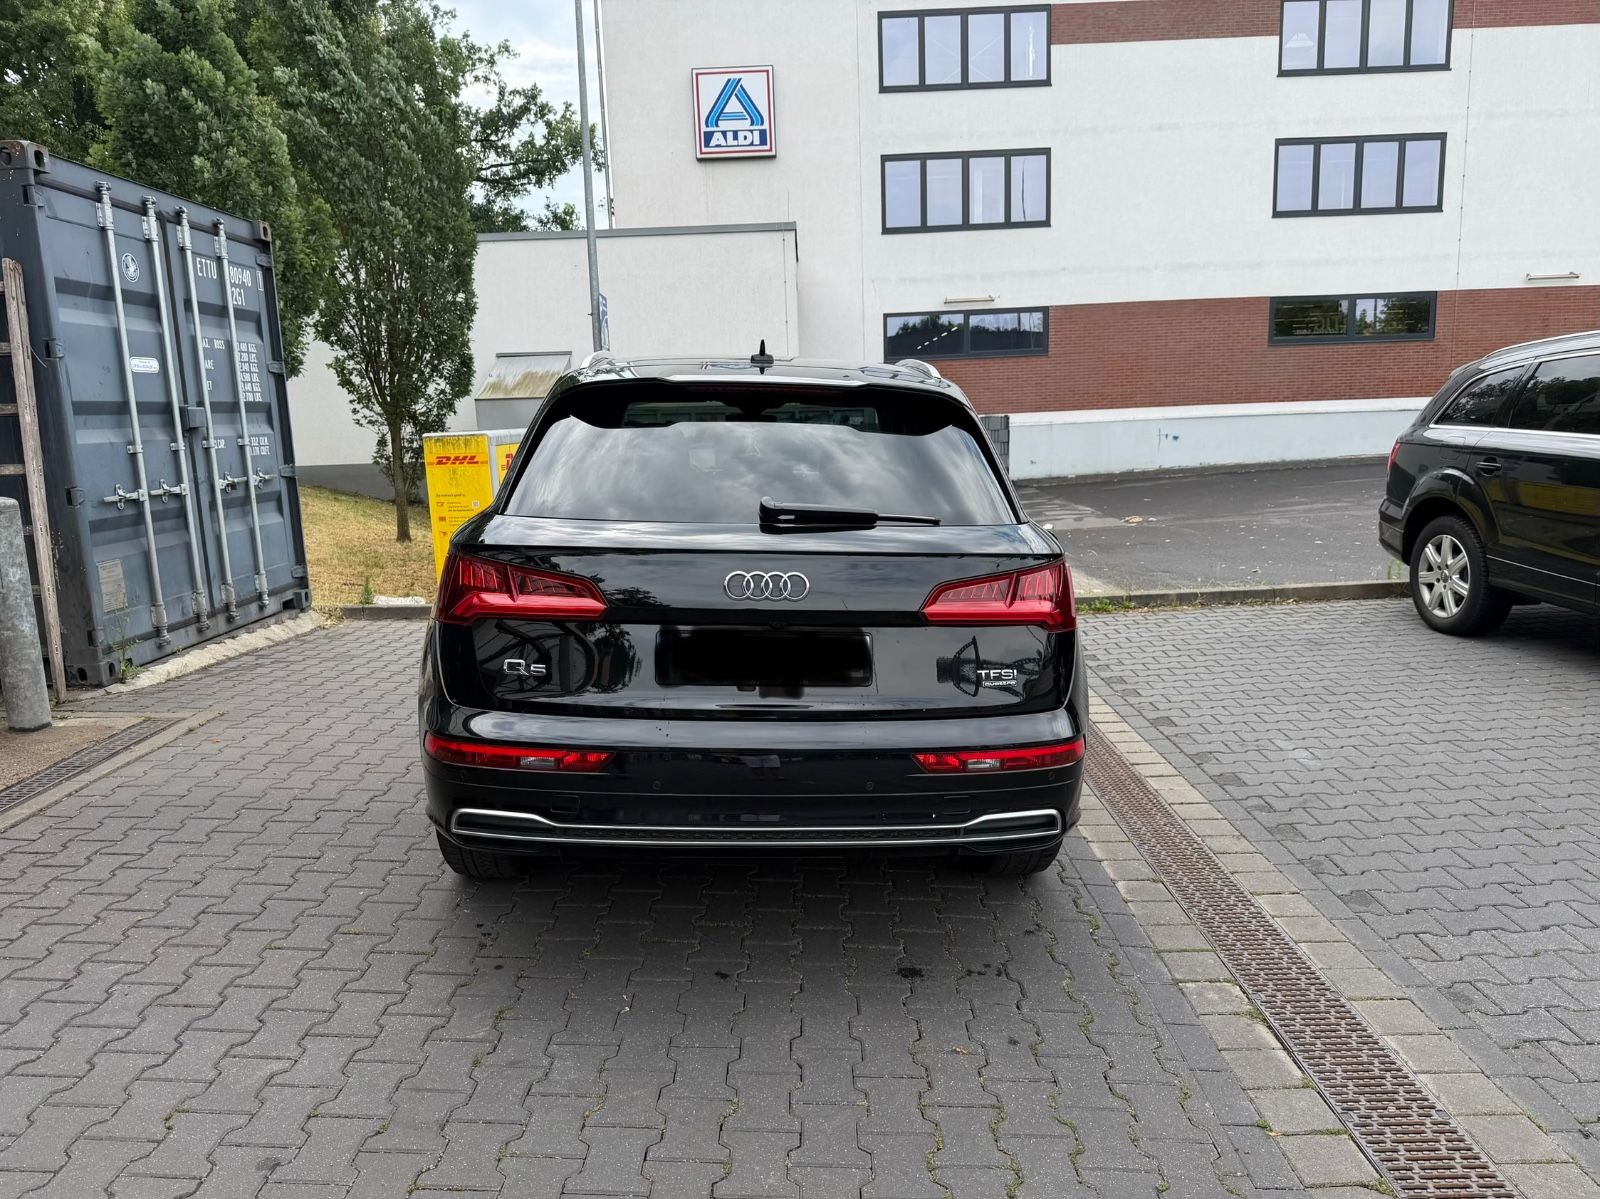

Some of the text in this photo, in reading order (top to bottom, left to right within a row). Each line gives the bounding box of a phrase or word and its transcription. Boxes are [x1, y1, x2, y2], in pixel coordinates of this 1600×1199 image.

[709, 130, 760, 146] ALDI
[196, 258, 217, 280] ETTU
[229, 266, 252, 287] 80940
[232, 287, 246, 306] 2G1
[204, 360, 214, 369] ARE
[435, 455, 480, 465] DHL
[503, 658, 547, 676] Q5
[977, 669, 1017, 680] TFSI
